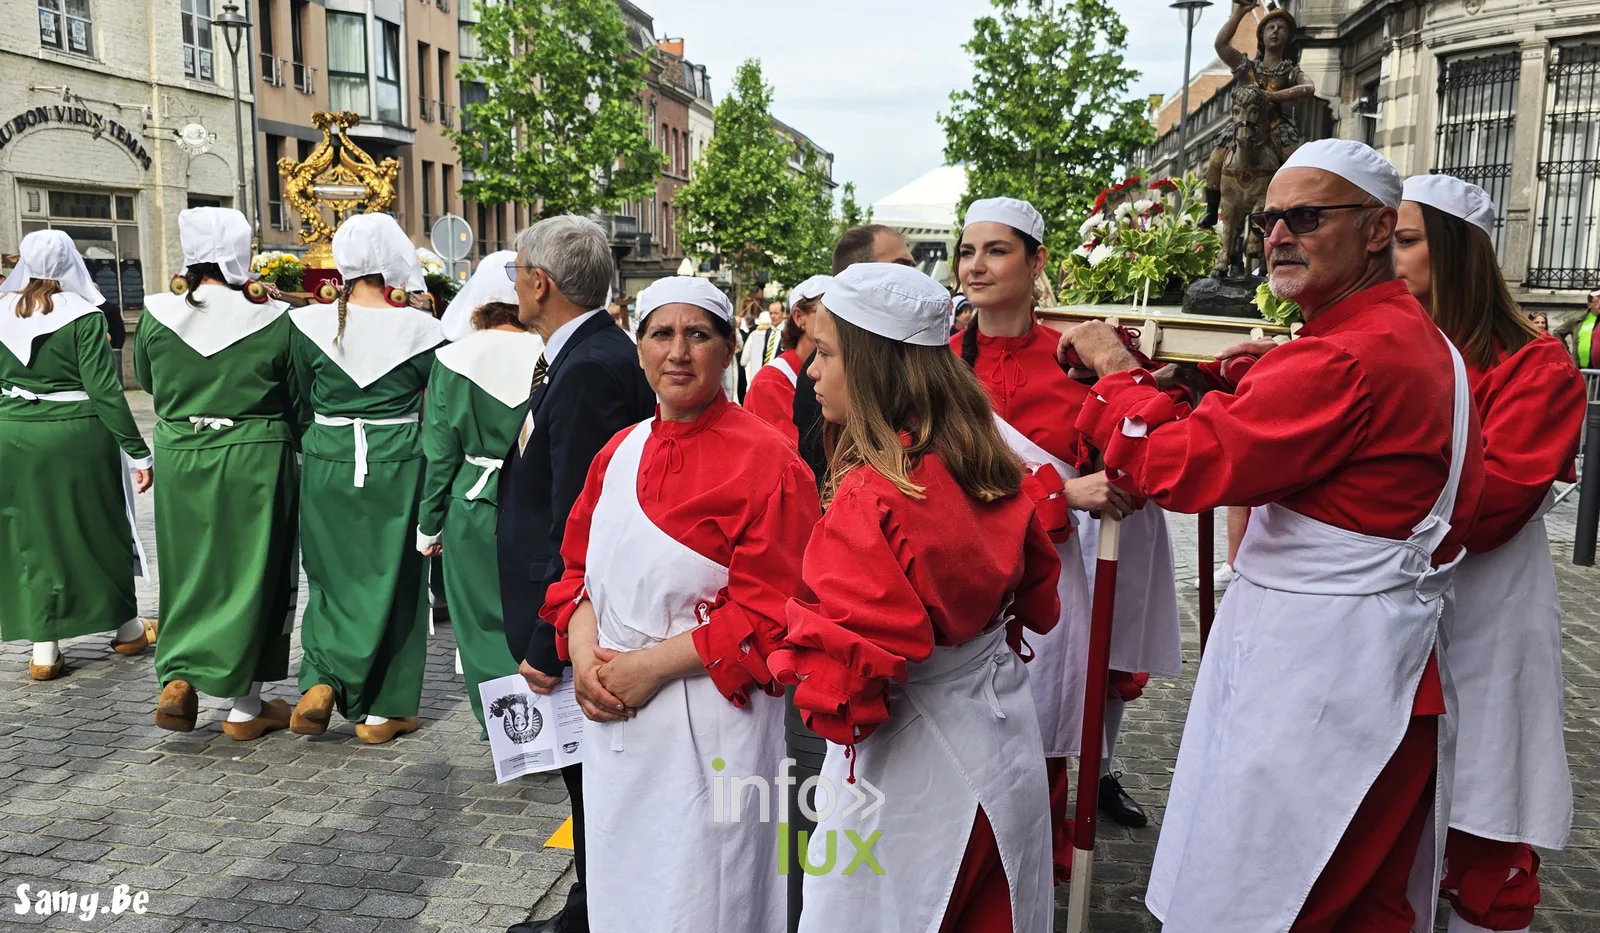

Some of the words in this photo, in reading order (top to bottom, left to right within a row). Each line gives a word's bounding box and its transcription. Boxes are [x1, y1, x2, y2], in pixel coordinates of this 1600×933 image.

[12, 106, 50, 134] BON
[54, 105, 103, 129] VIEUX
[109, 119, 152, 170] TEMPS
